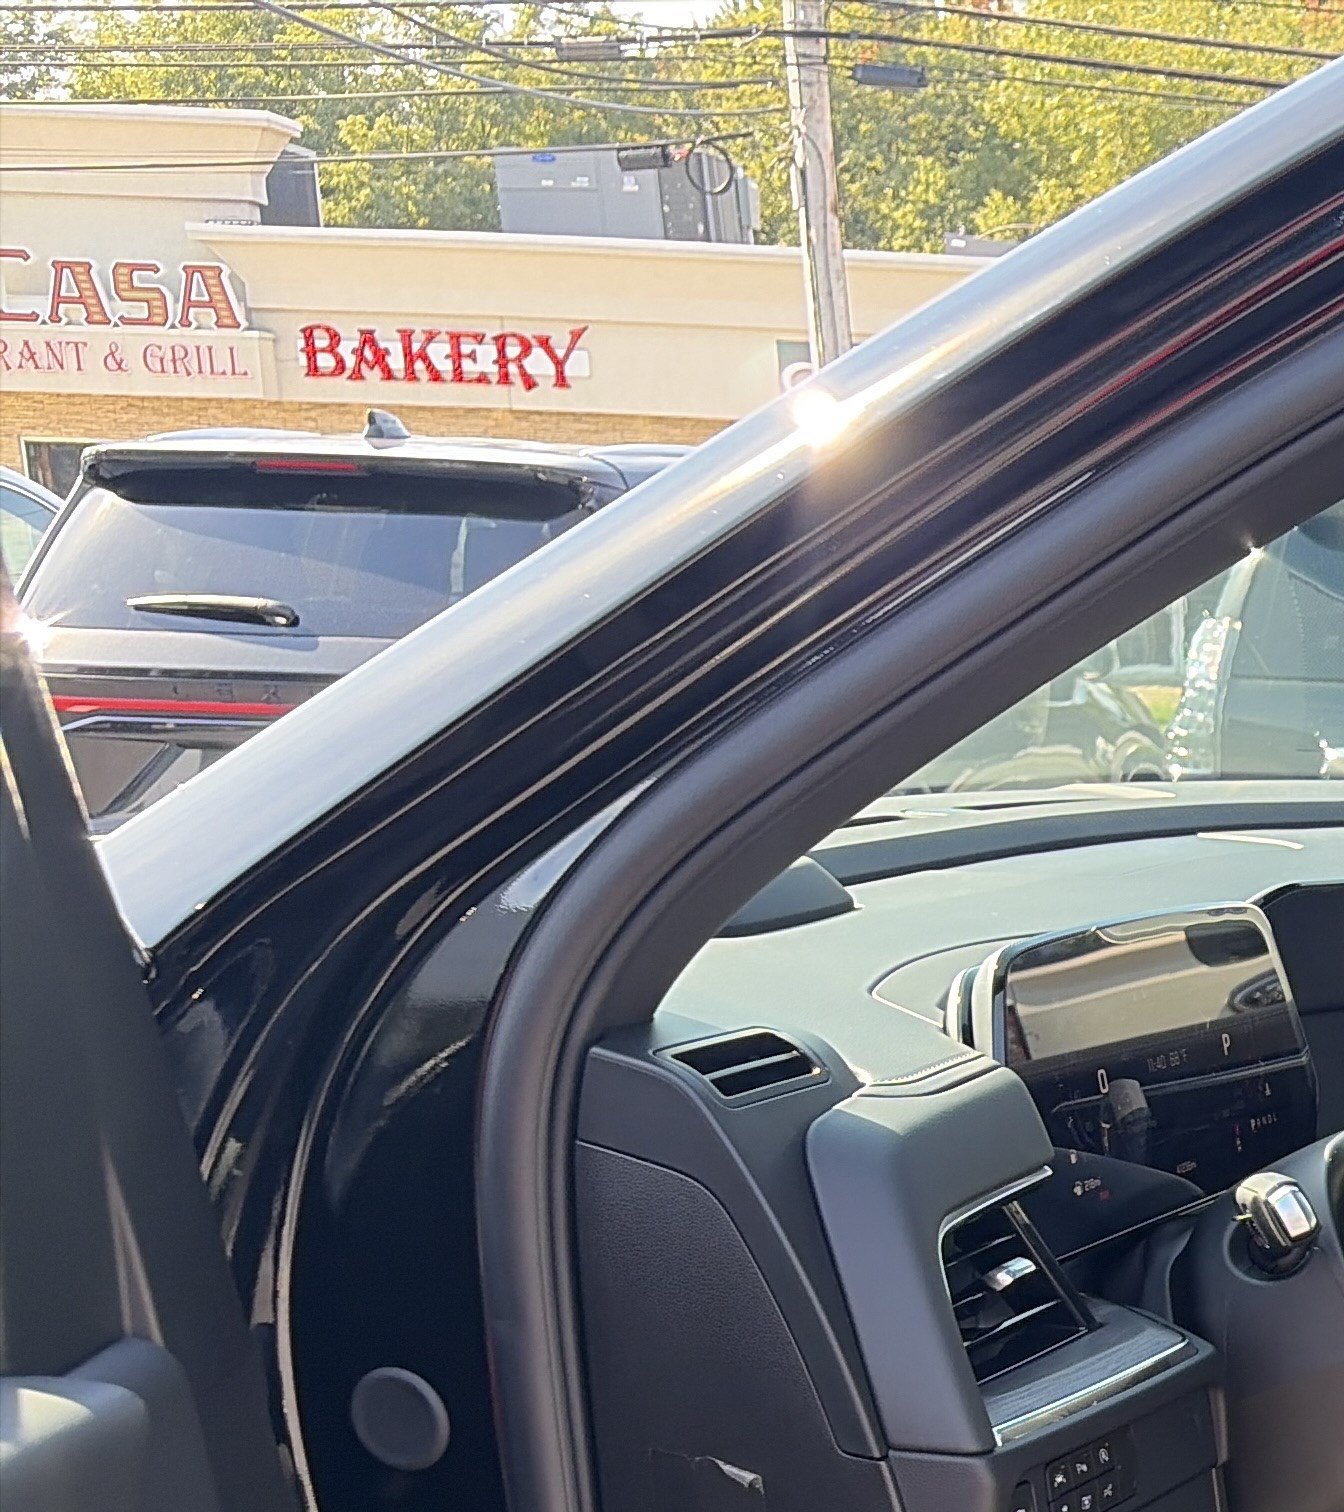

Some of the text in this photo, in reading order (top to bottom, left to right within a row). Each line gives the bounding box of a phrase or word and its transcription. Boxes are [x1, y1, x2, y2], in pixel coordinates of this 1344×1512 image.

[104, 340, 129, 373] &
[143, 343, 249, 377] GRILL
[301, 323, 589, 391] BAKERY
[1221, 1033, 1231, 1056] P
